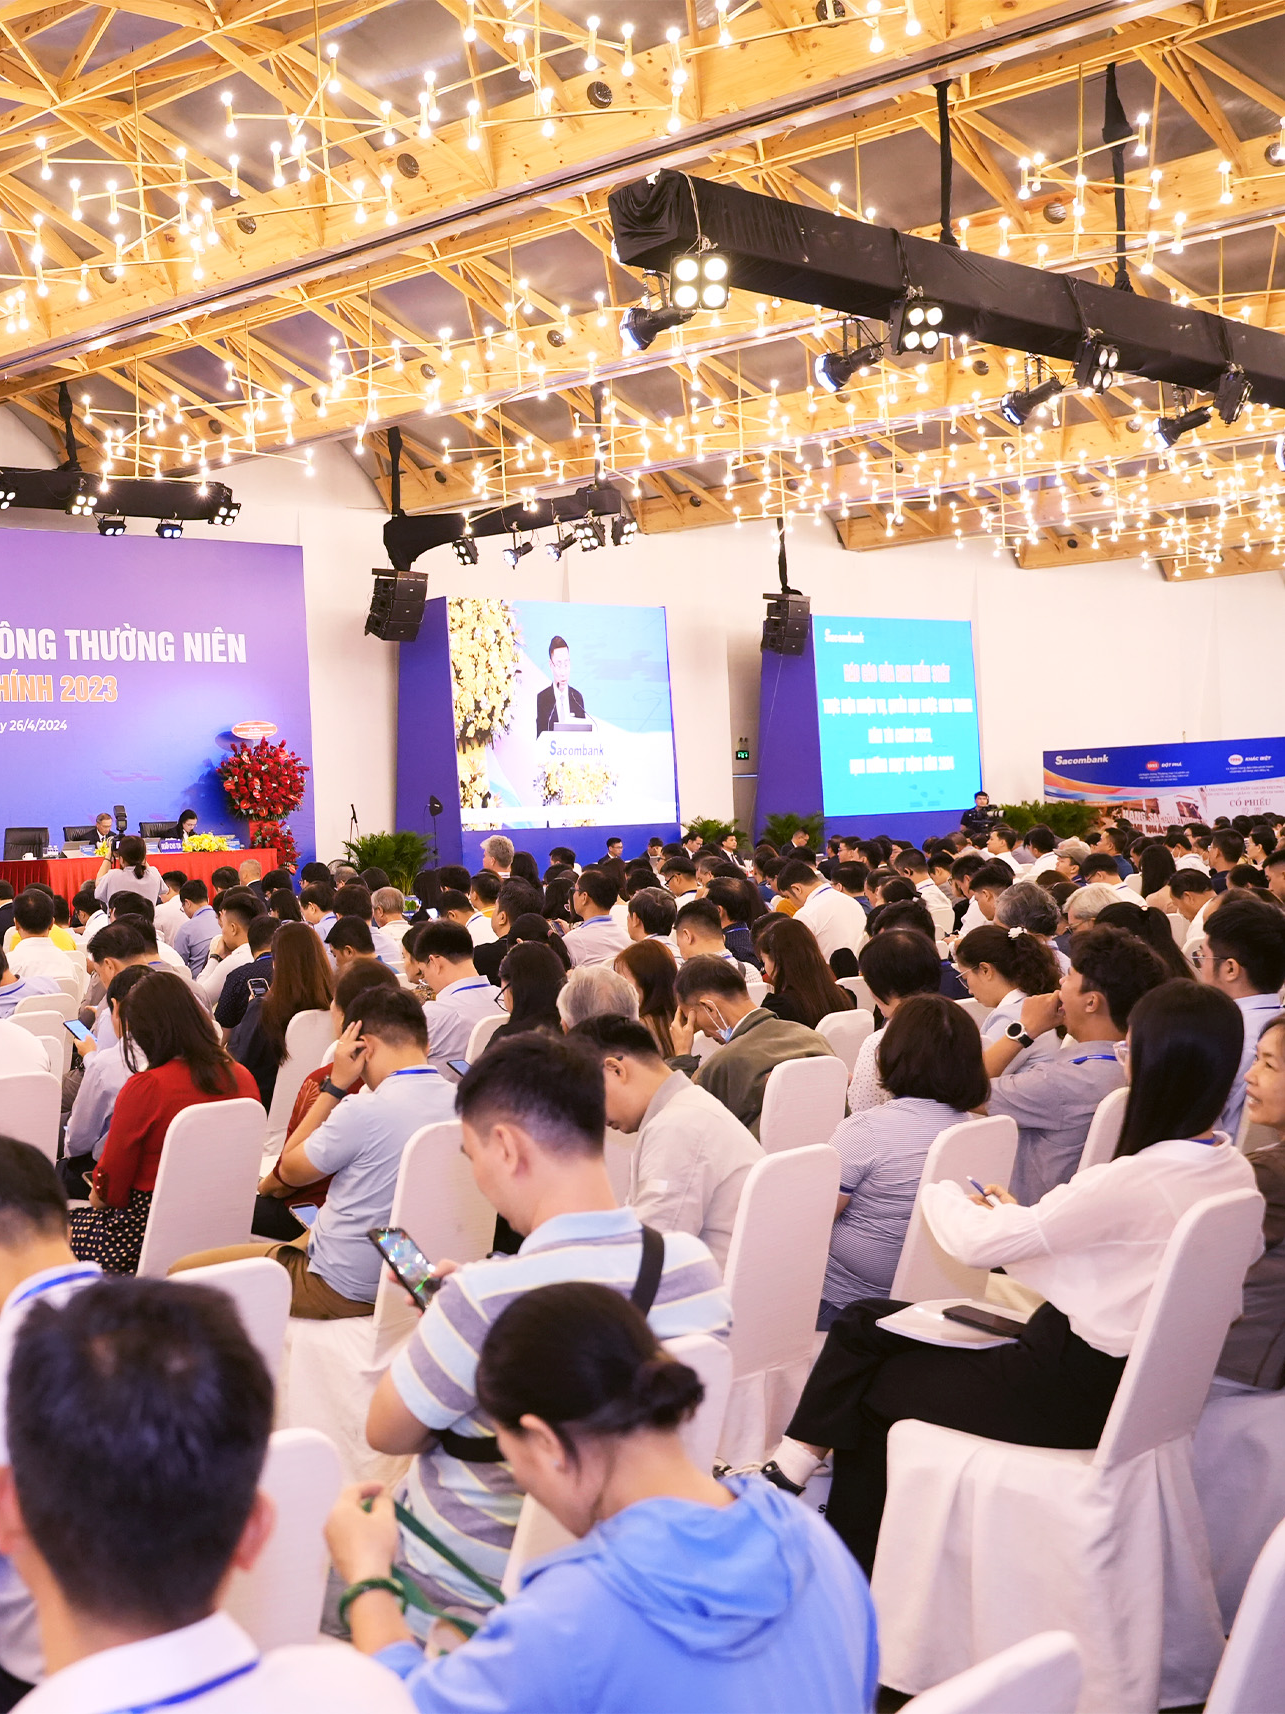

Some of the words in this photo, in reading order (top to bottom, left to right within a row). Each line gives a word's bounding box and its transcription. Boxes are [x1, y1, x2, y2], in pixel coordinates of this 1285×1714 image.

[65, 622, 175, 661] THƯỜNG
[183, 627, 247, 663] NIÊN
[60, 675, 118, 703] 2023
[10, 718, 68, 732] 26/4/2024
[549, 740, 604, 756] Sacombank
[1055, 754, 1109, 766] Sacombank
